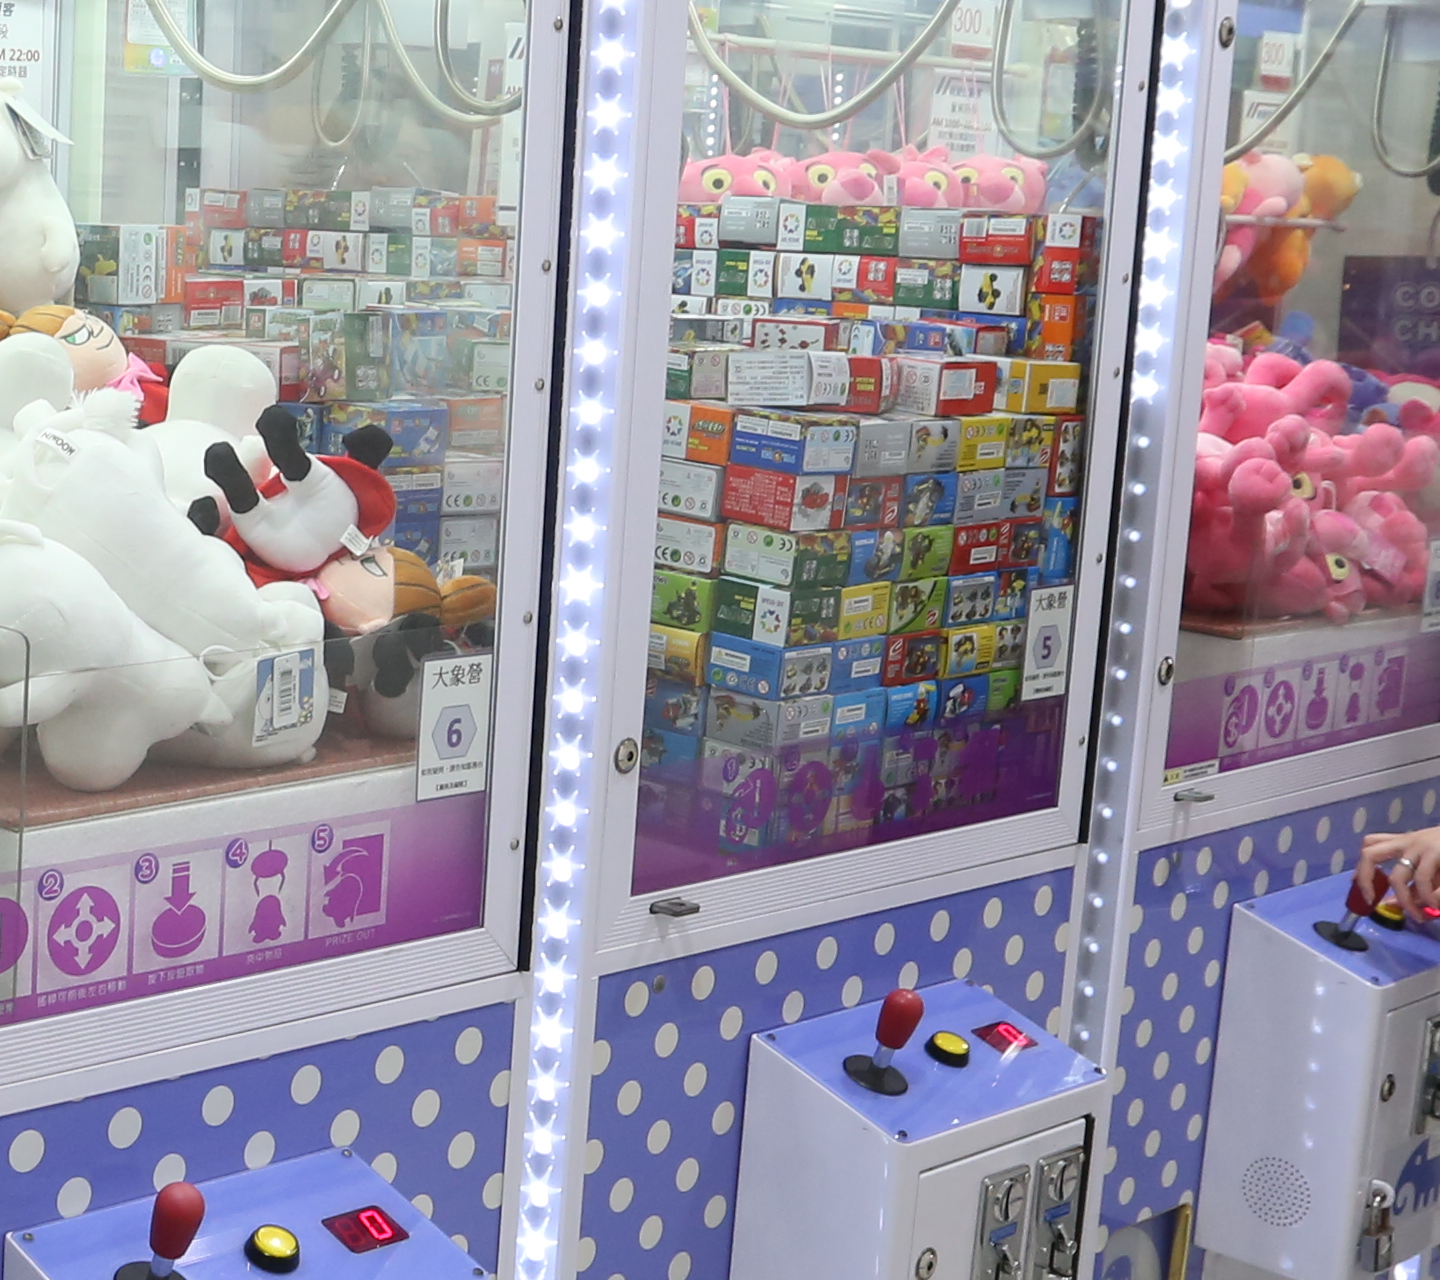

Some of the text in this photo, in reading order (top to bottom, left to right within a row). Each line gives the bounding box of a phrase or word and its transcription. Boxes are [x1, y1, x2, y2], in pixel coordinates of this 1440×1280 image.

[1041, 635, 1052, 660] 5
[432, 662, 483, 690] 大象營
[447, 717, 463, 748] 6
[315, 827, 329, 849] 5
[228, 842, 247, 864] 4
[139, 857, 156, 880] 3
[42, 873, 60, 897] 2
[325, 928, 376, 948] PRIZE OUT
[358, 1208, 394, 1240] 0
